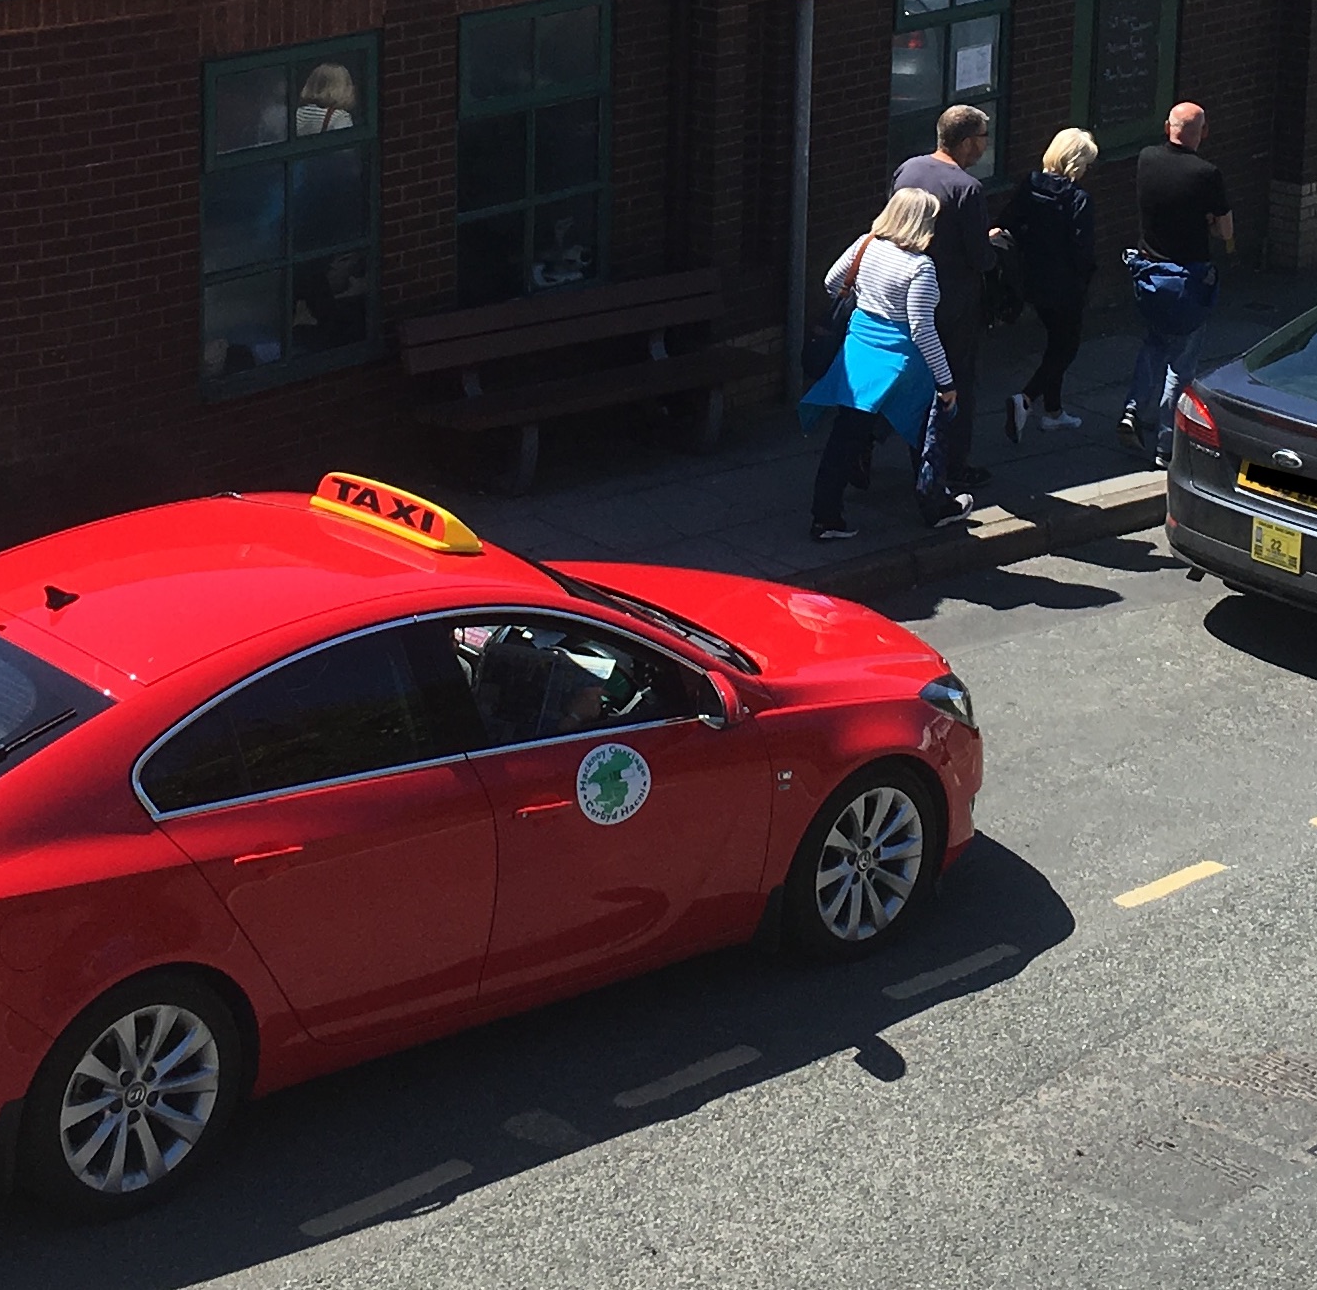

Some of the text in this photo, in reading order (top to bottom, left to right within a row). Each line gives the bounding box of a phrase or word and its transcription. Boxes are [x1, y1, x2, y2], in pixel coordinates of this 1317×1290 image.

[331, 477, 435, 534] TAXI
[1271, 538, 1282, 552] 22
[580, 749, 606, 791] Hackney
[586, 788, 646, 823] Cerbyd Hacni
